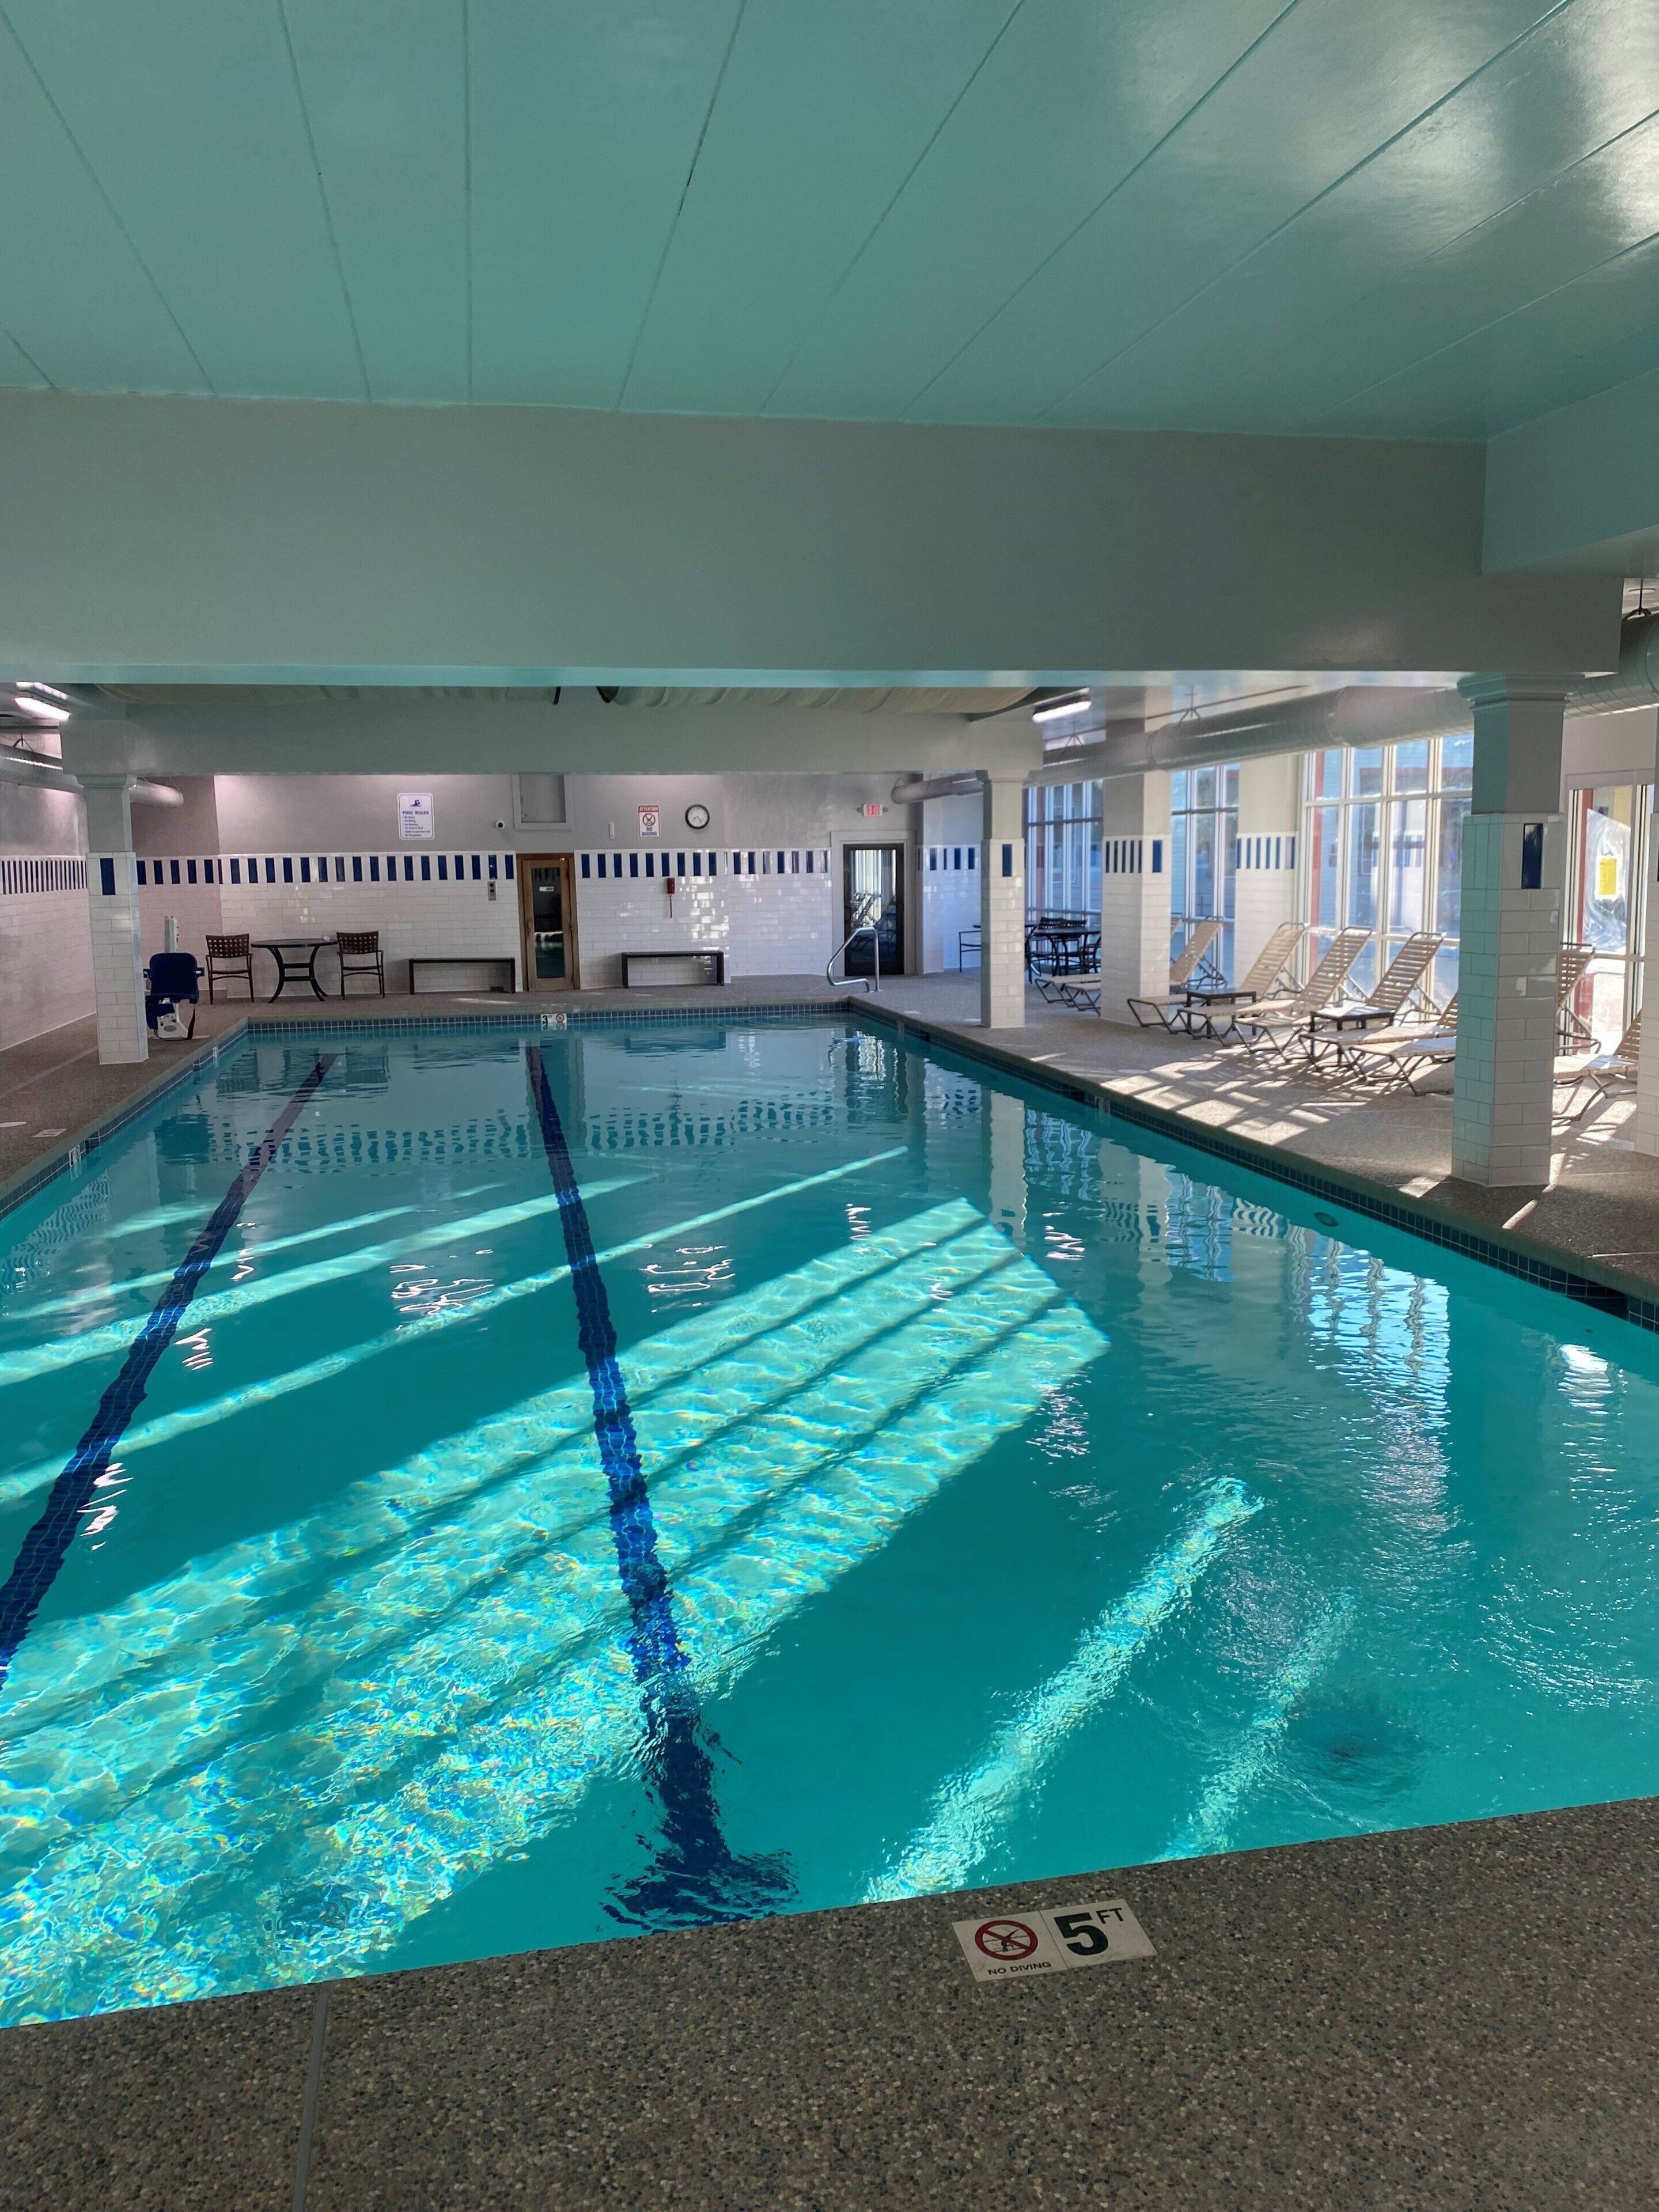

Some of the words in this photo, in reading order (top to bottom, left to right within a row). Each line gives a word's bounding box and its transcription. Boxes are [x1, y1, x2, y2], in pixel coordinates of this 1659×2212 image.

[867, 805, 881, 816] EXIT
[1054, 1912, 1109, 1956] 5
[1096, 1907, 1125, 1925] FT
[987, 1967, 1007, 1976] NO
[1009, 1961, 1052, 1973] DIVING
